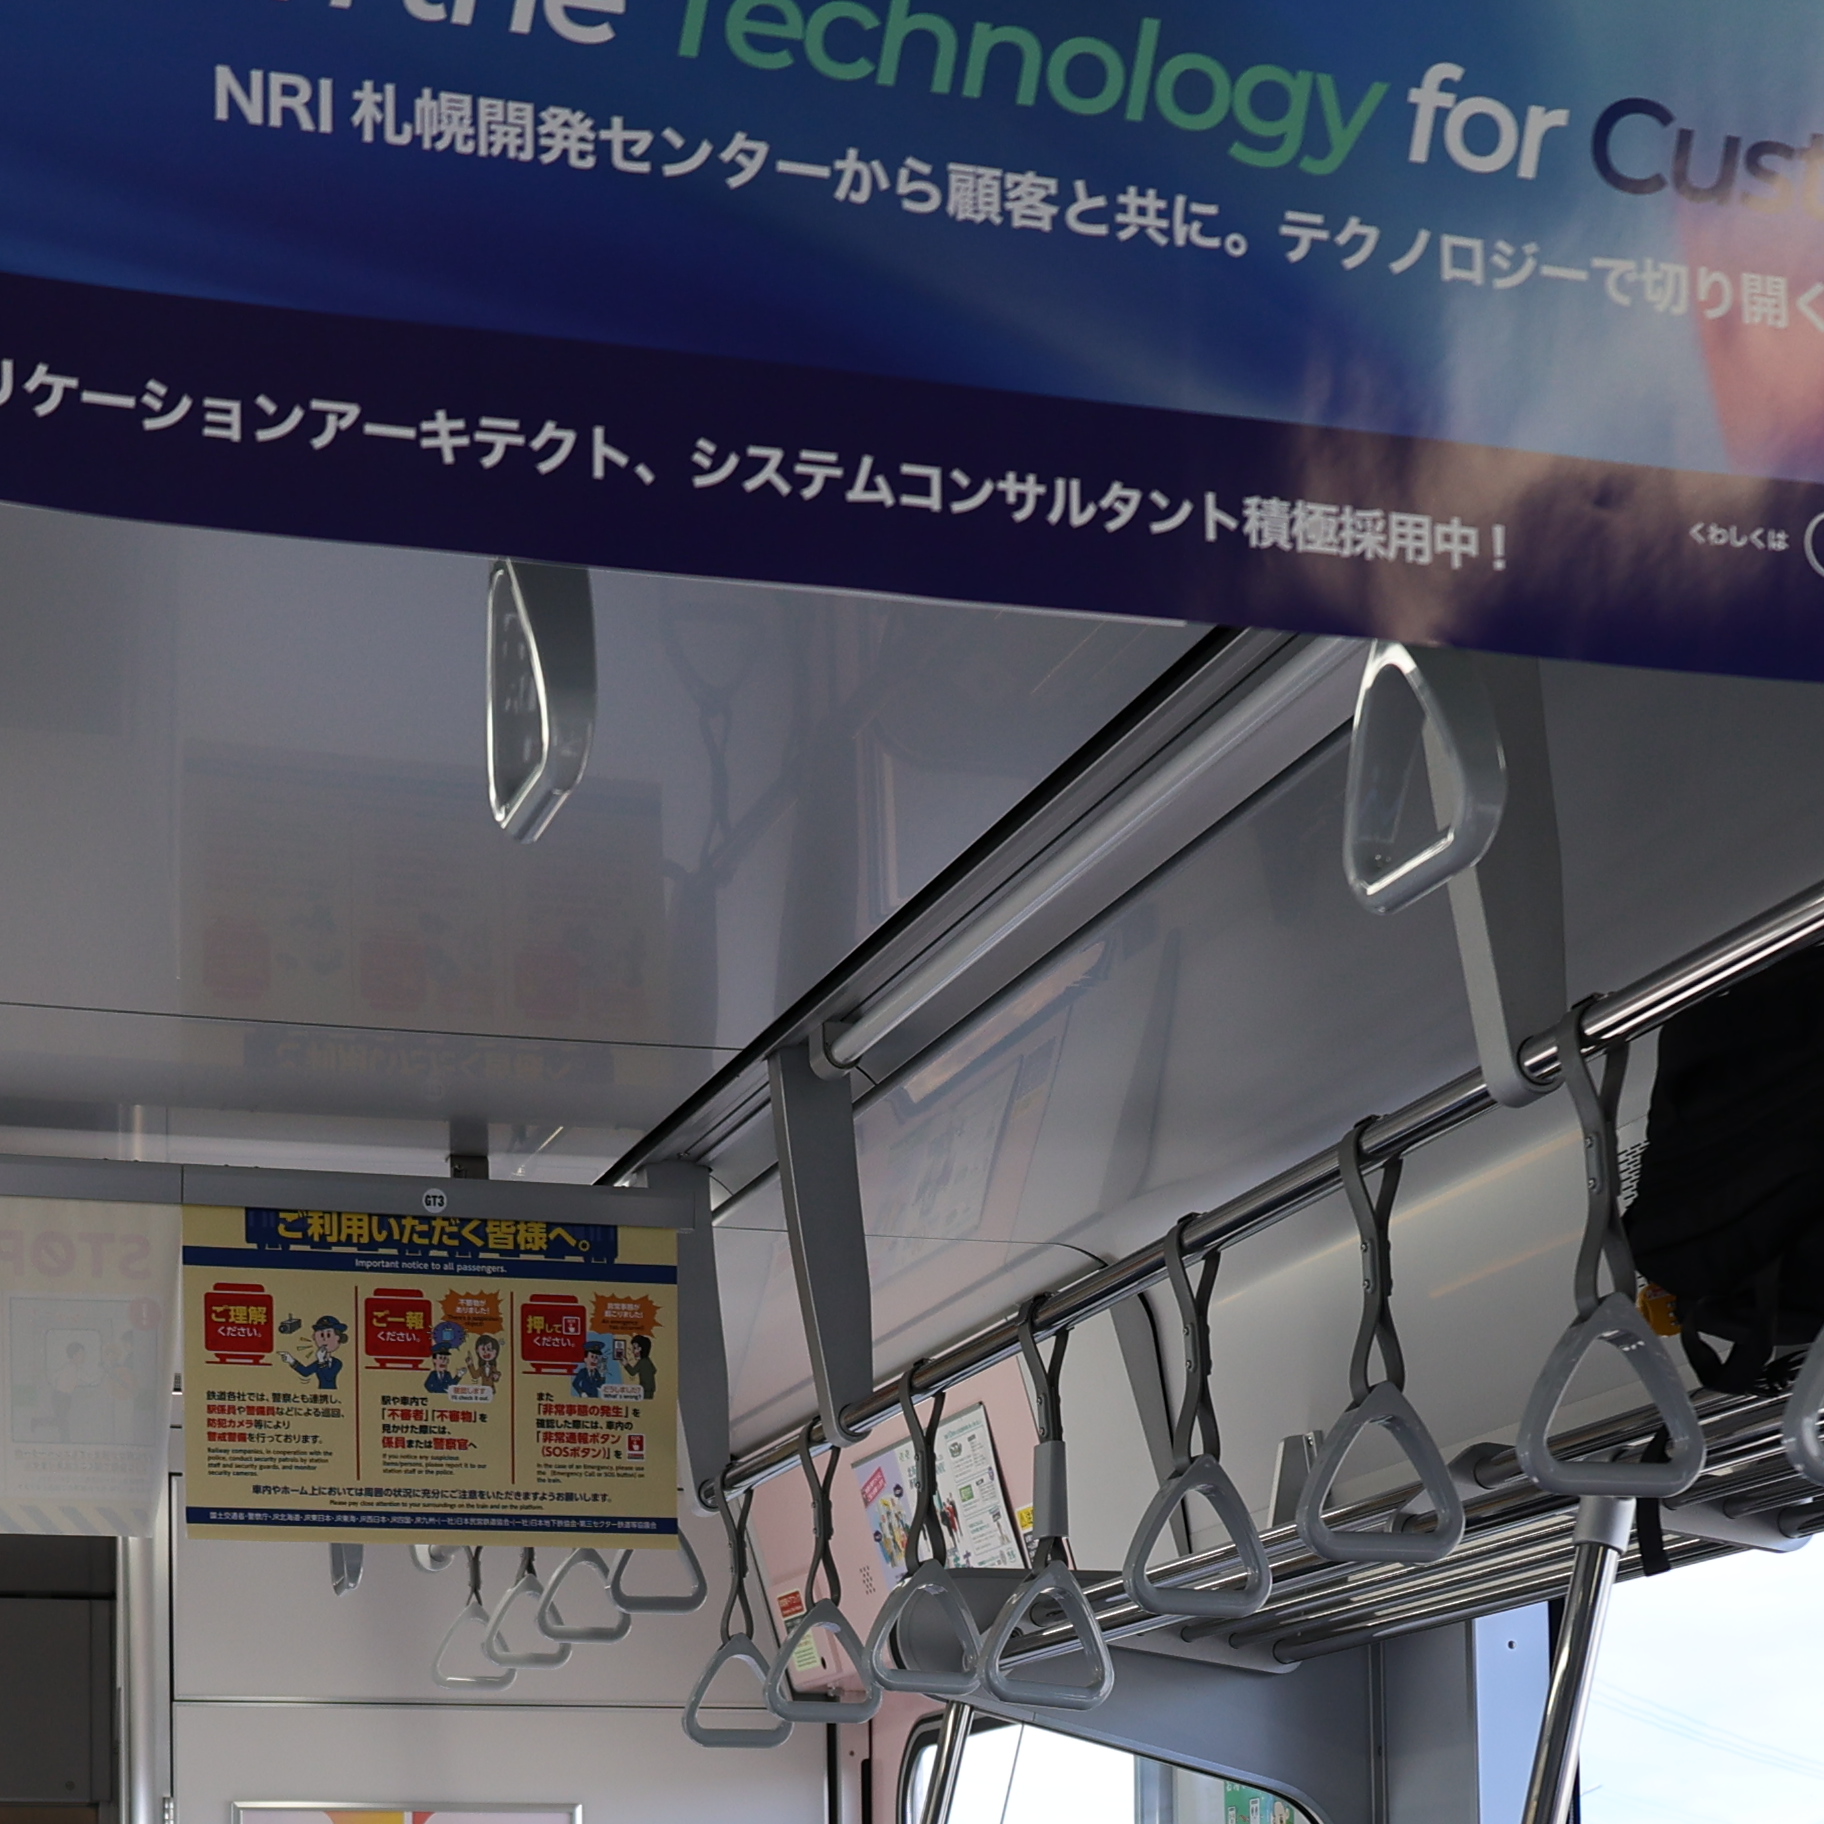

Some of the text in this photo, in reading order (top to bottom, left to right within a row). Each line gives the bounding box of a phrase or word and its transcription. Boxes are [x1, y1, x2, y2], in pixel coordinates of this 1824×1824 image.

[213, 65, 332, 136] NRI
[1405, 62, 1570, 181] for
[1688, 522, 1790, 552] くわしくは
[424, 1193, 446, 1208] GT3
[277, 1210, 591, 1252] ご利用いただく皆様へ。
[356, 1258, 508, 1275] Important notice to all passengers.
[211, 1304, 268, 1325] ご理解
[373, 1310, 424, 1329] ご一報
[217, 1326, 263, 1338] ください。
[526, 1315, 562, 1335] 押して
[377, 1331, 422, 1343] ください。
[533, 1337, 576, 1349] ください。
[381, 1395, 429, 1407] 駅や車内で
[536, 1393, 554, 1402] また
[207, 1418, 291, 1432] 防犯カメラ等により
[382, 1424, 452, 1436] 見かけた際には、
[536, 1418, 634, 1432] 確認した際には、車内の
[207, 1431, 324, 1445] 警戒警備を行っております。
[382, 1436, 478, 1451] 係員または警察官へ
